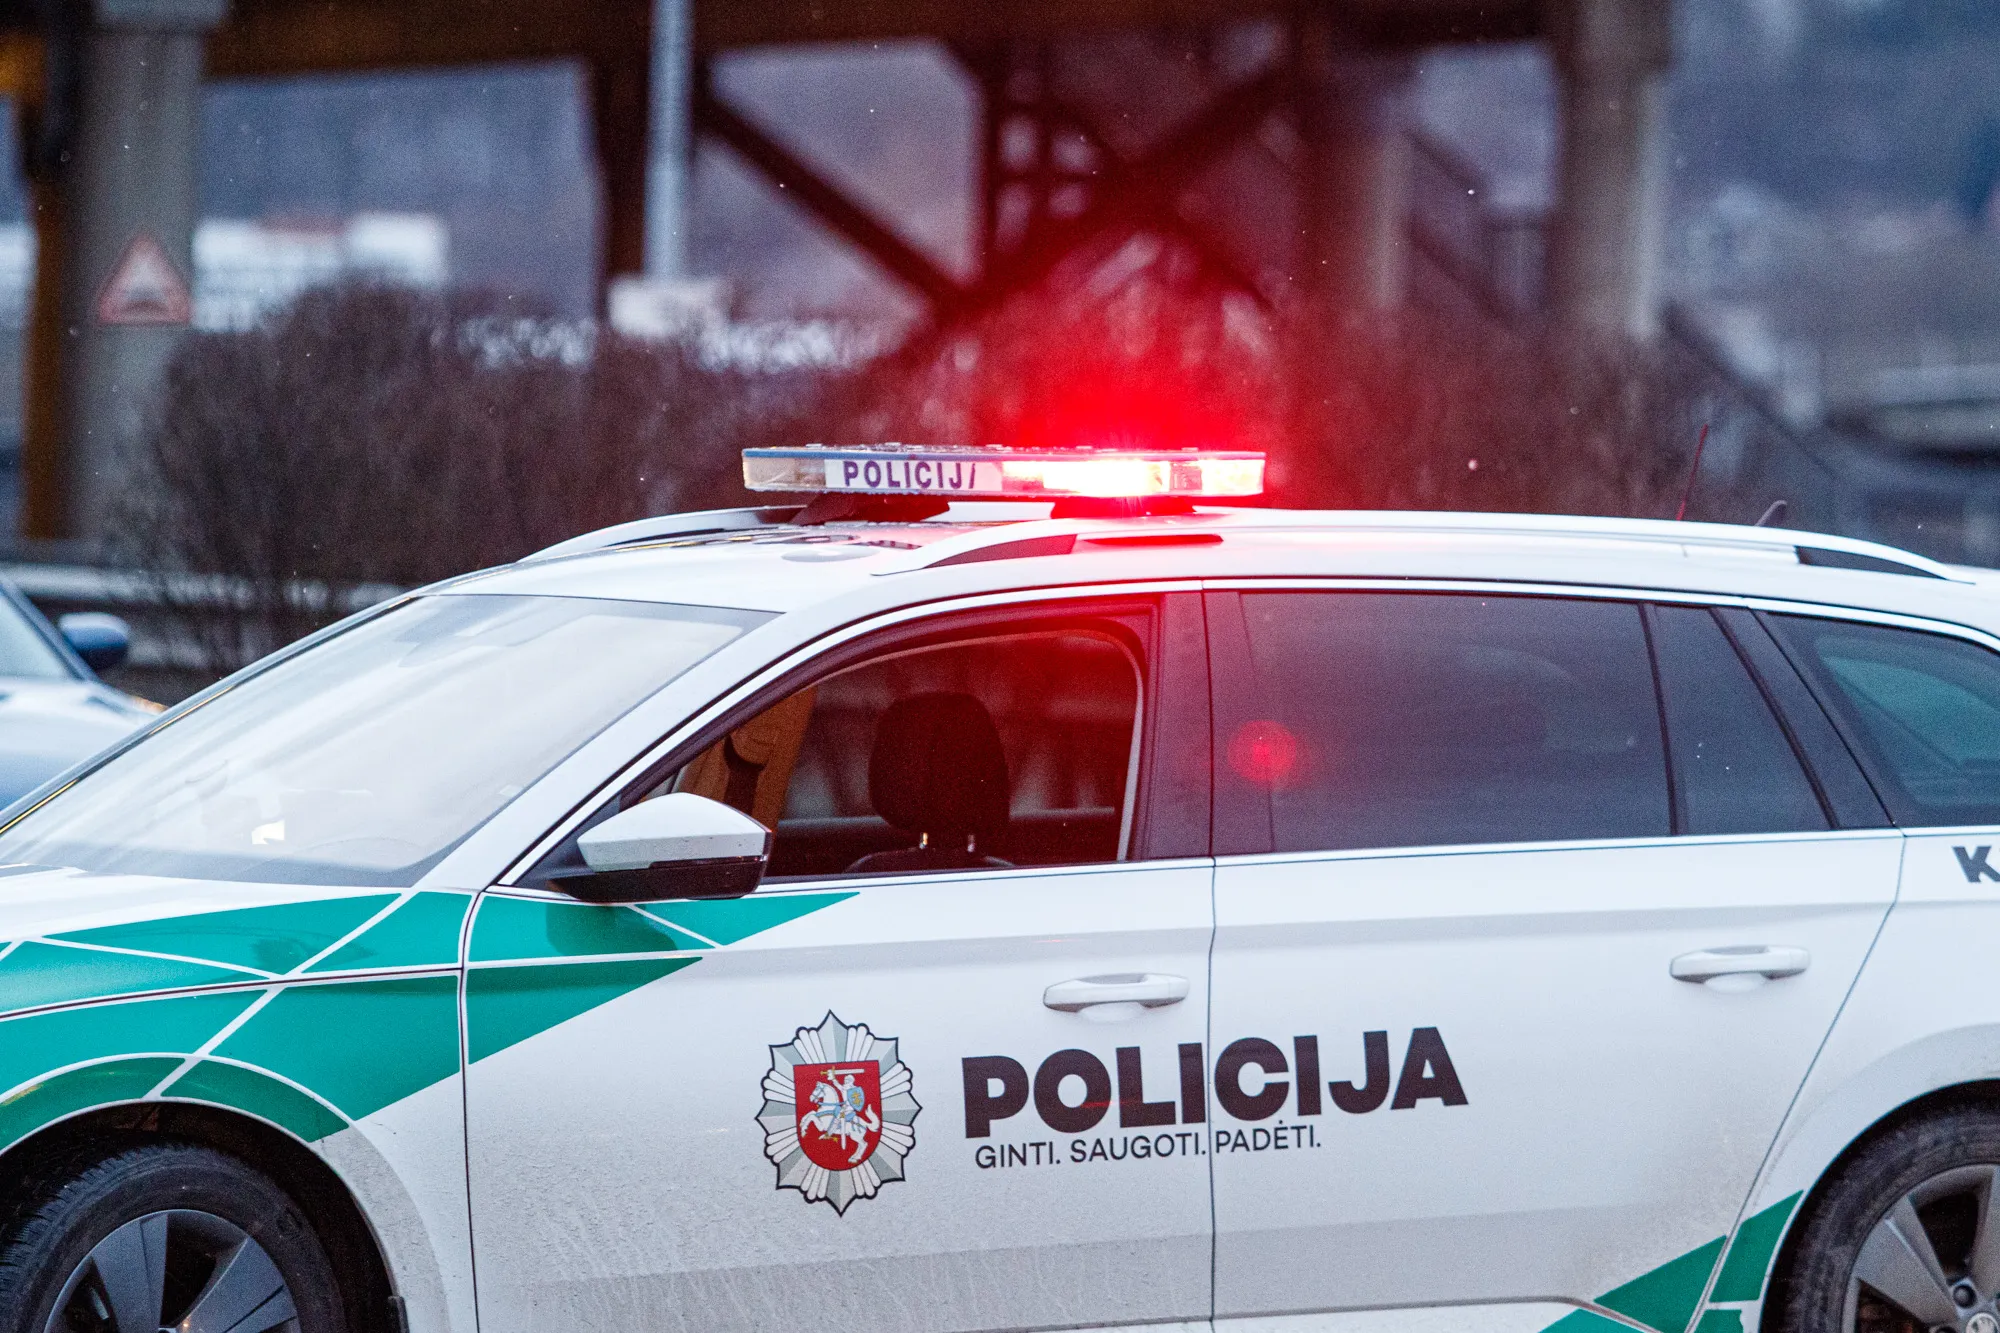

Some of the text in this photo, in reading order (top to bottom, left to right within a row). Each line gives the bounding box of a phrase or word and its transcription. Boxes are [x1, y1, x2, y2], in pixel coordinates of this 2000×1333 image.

[962, 1026, 1469, 1138] POLICIJA
[975, 1120, 1321, 1169] GINTI. SAUGOTI. PADĖTI.
